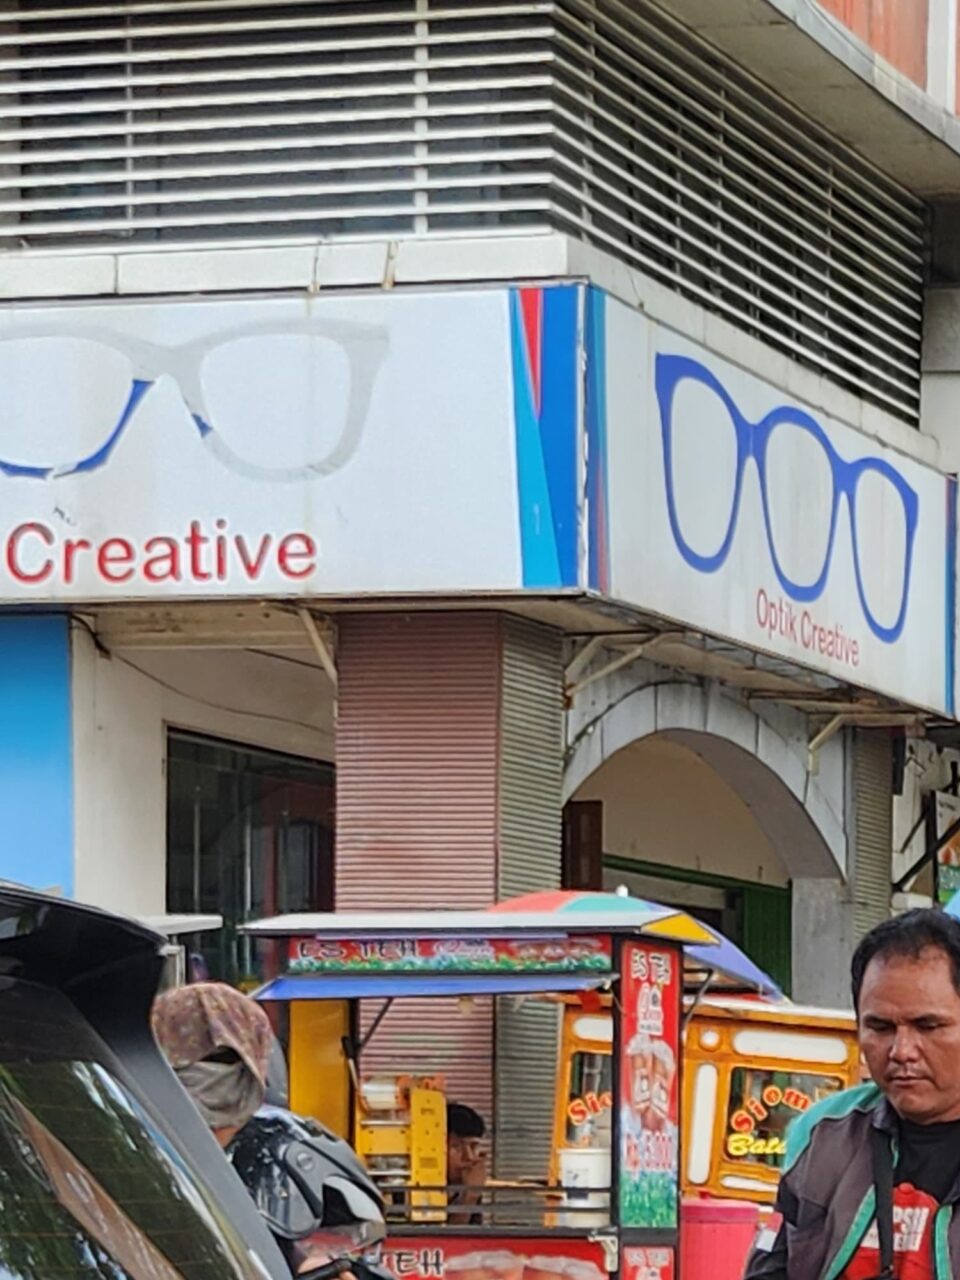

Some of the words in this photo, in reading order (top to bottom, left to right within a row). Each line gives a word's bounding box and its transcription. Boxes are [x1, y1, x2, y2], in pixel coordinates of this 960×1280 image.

[6, 518, 319, 584] Creative
[757, 588, 797, 643] Optik
[801, 610, 859, 667] Creative
